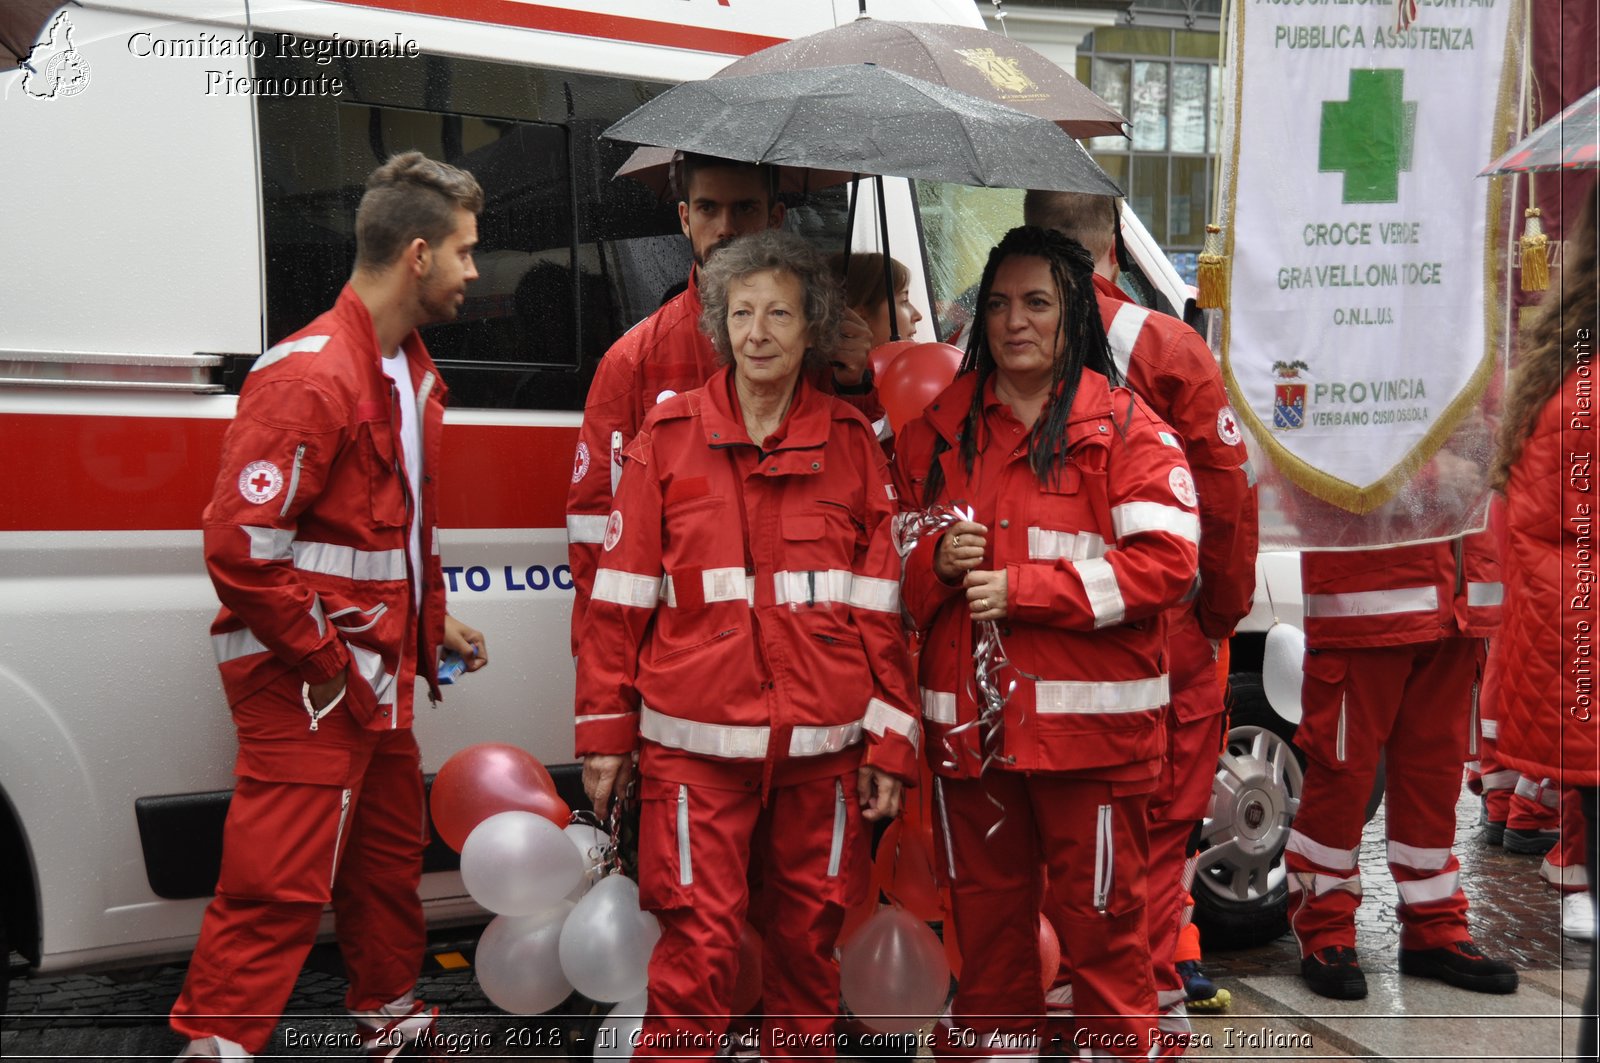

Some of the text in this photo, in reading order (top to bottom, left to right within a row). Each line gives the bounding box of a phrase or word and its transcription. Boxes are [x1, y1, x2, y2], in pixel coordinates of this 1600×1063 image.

[1274, 25, 1474, 50] PUBBLICA ASSISTENZA
[1303, 222, 1421, 246] CROCE VERDE
[1277, 262, 1442, 290] GRAVELLONA TOCE
[1333, 307, 1394, 325] O.N.L.U.S.
[1314, 378, 1427, 404] PROVINCIA
[1312, 406, 1428, 426] VERBANO CUSIO OSSOLA
